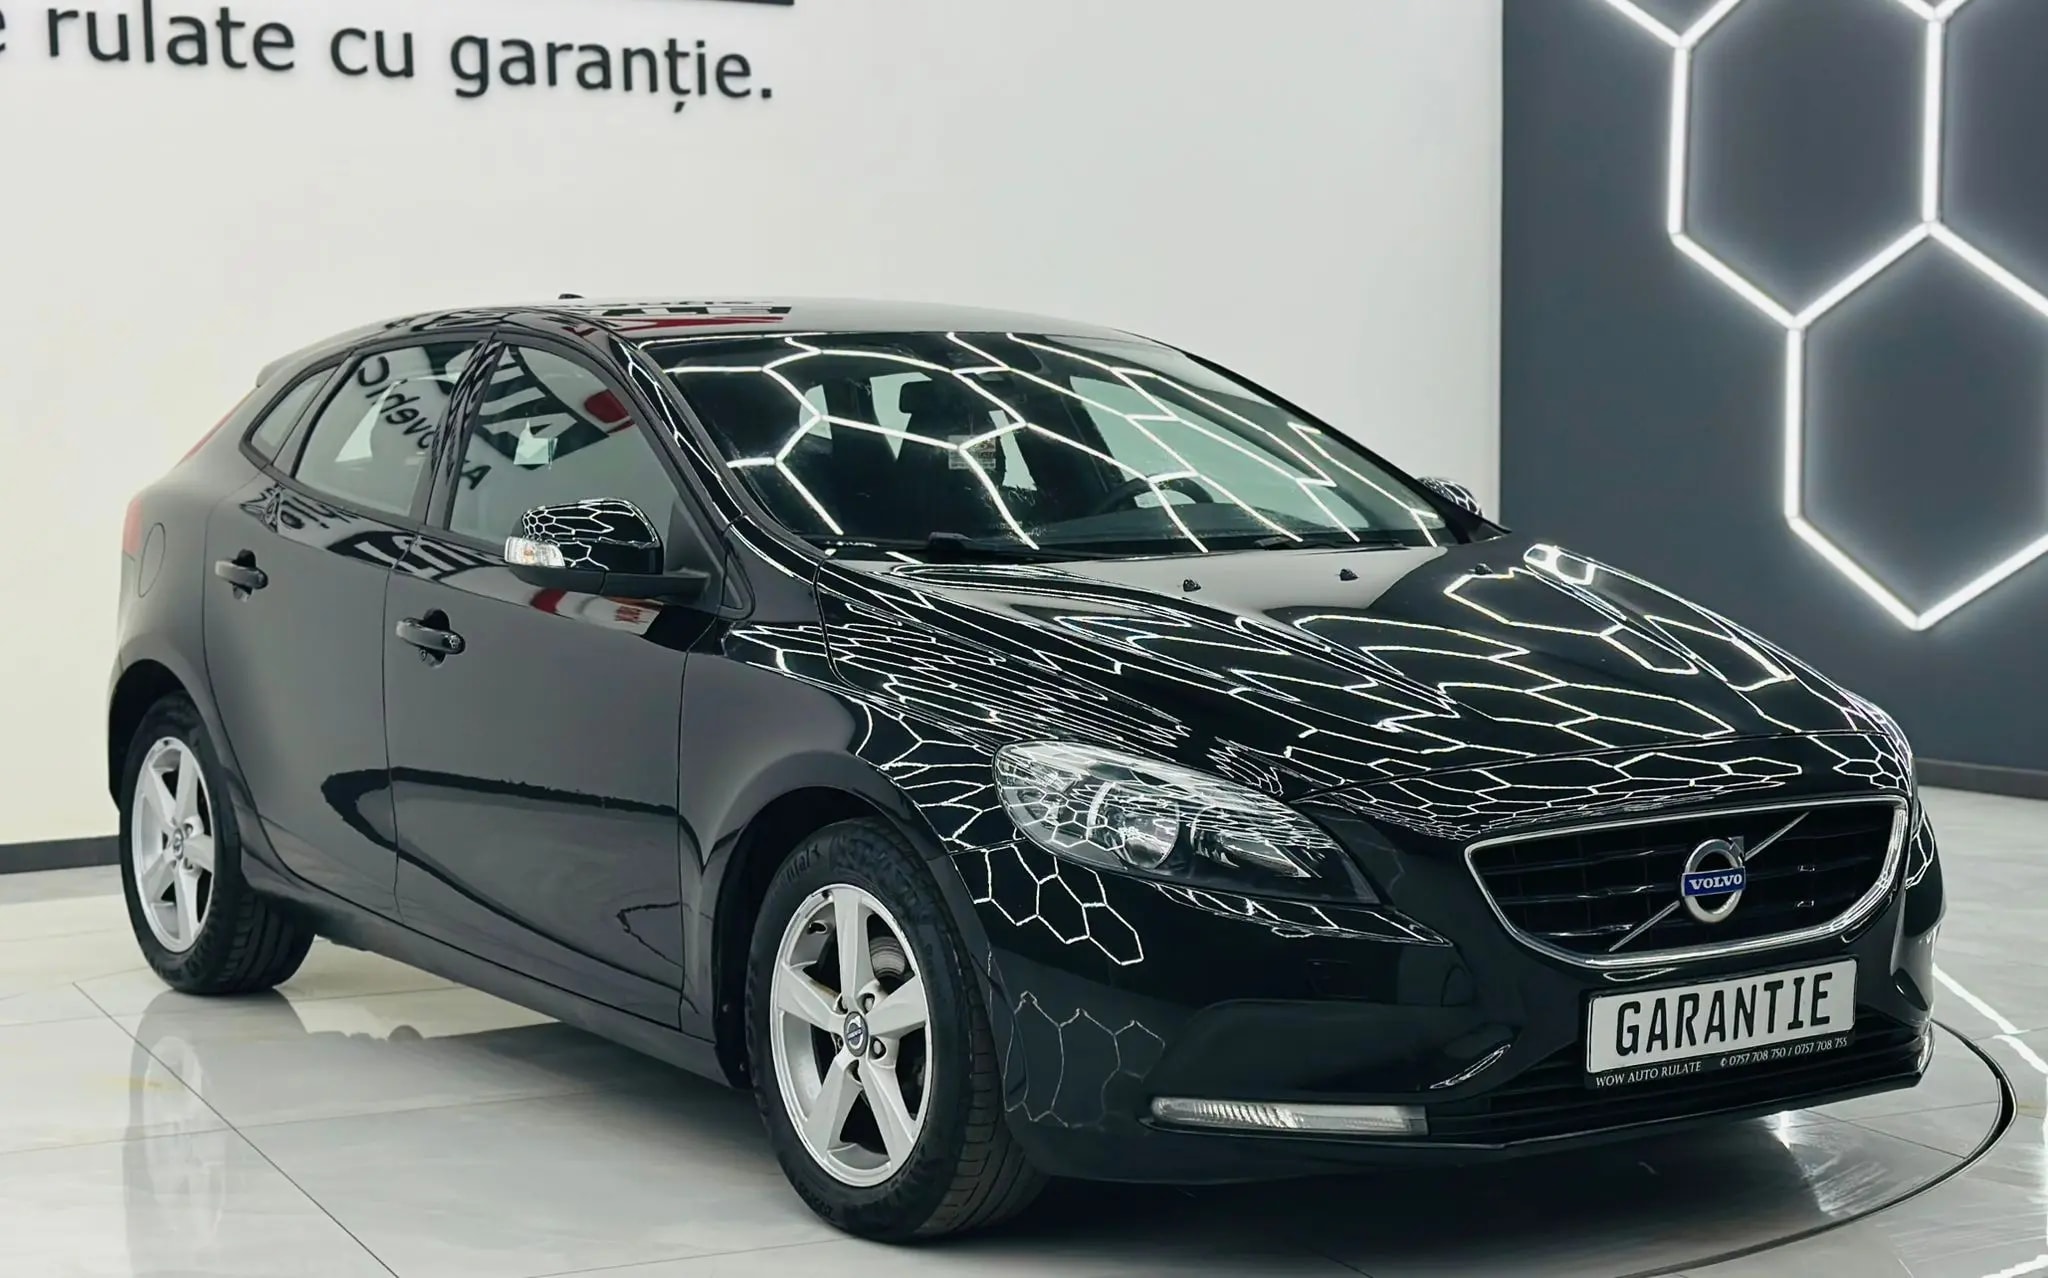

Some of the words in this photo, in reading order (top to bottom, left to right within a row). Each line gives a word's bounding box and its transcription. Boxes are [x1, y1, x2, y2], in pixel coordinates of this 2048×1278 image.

[48, 0, 294, 72] rulate
[331, 28, 414, 78] cu
[451, 36, 771, 113] garanție.
[1689, 873, 1742, 890] VOLVO
[1616, 972, 1833, 1056] GARANTIE
[1596, 1073, 1624, 1088] WOW
[1628, 1068, 1658, 1083] AUTO
[1661, 1061, 1702, 1077] RULATE
[1729, 1053, 1750, 1066] 0757
[1752, 1050, 1768, 1062] 708
[1771, 1047, 1786, 1059] 750
[1794, 1042, 1814, 1055] 0757
[1816, 1040, 1832, 1051] 708
